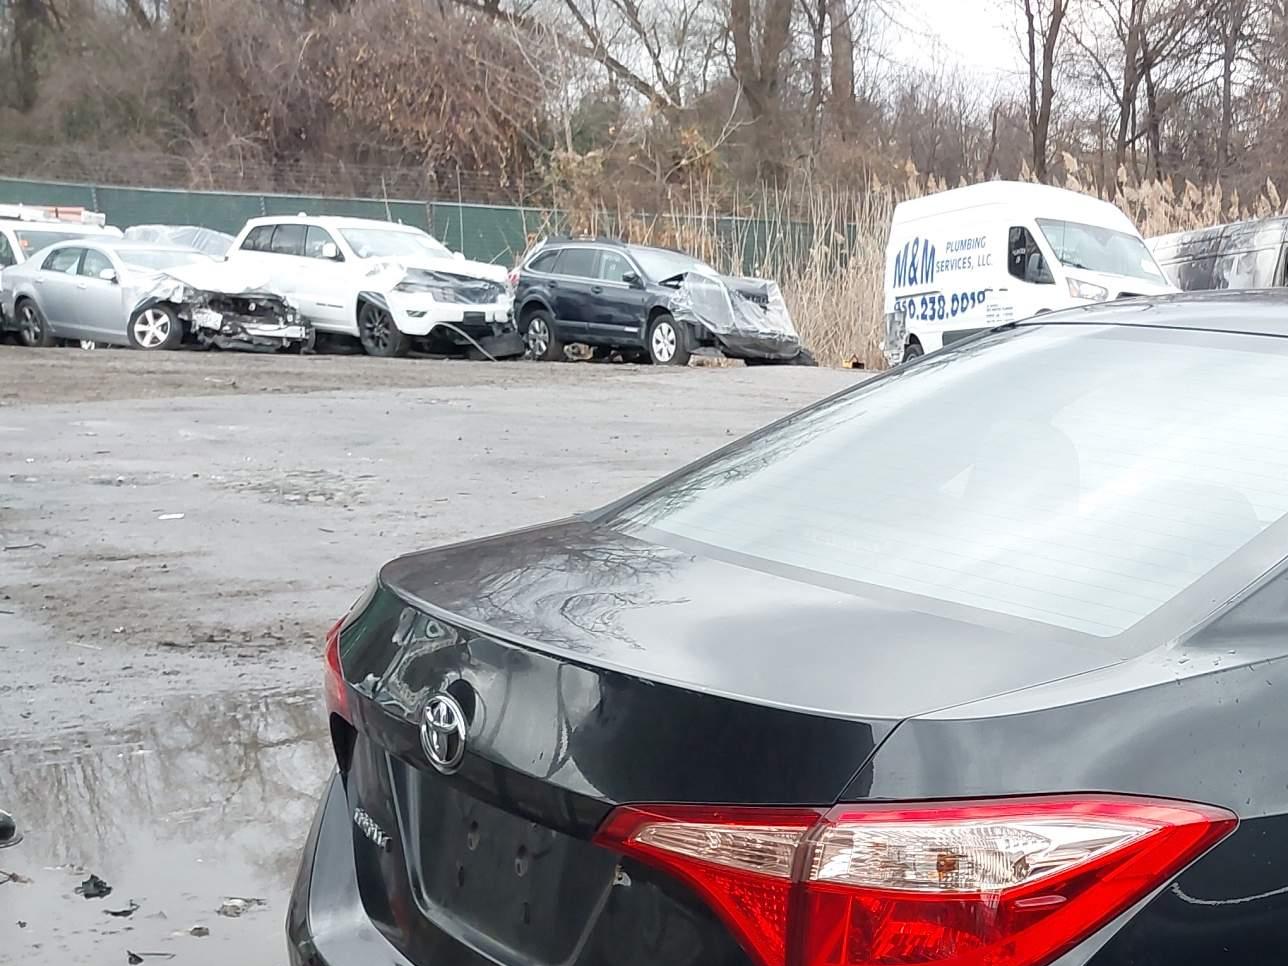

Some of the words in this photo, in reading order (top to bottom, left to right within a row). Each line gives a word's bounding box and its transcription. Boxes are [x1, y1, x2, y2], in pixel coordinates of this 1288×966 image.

[946, 236, 986, 253] PLUMBING
[893, 237, 935, 288] M&M
[936, 256, 974, 272] SERVICES,
